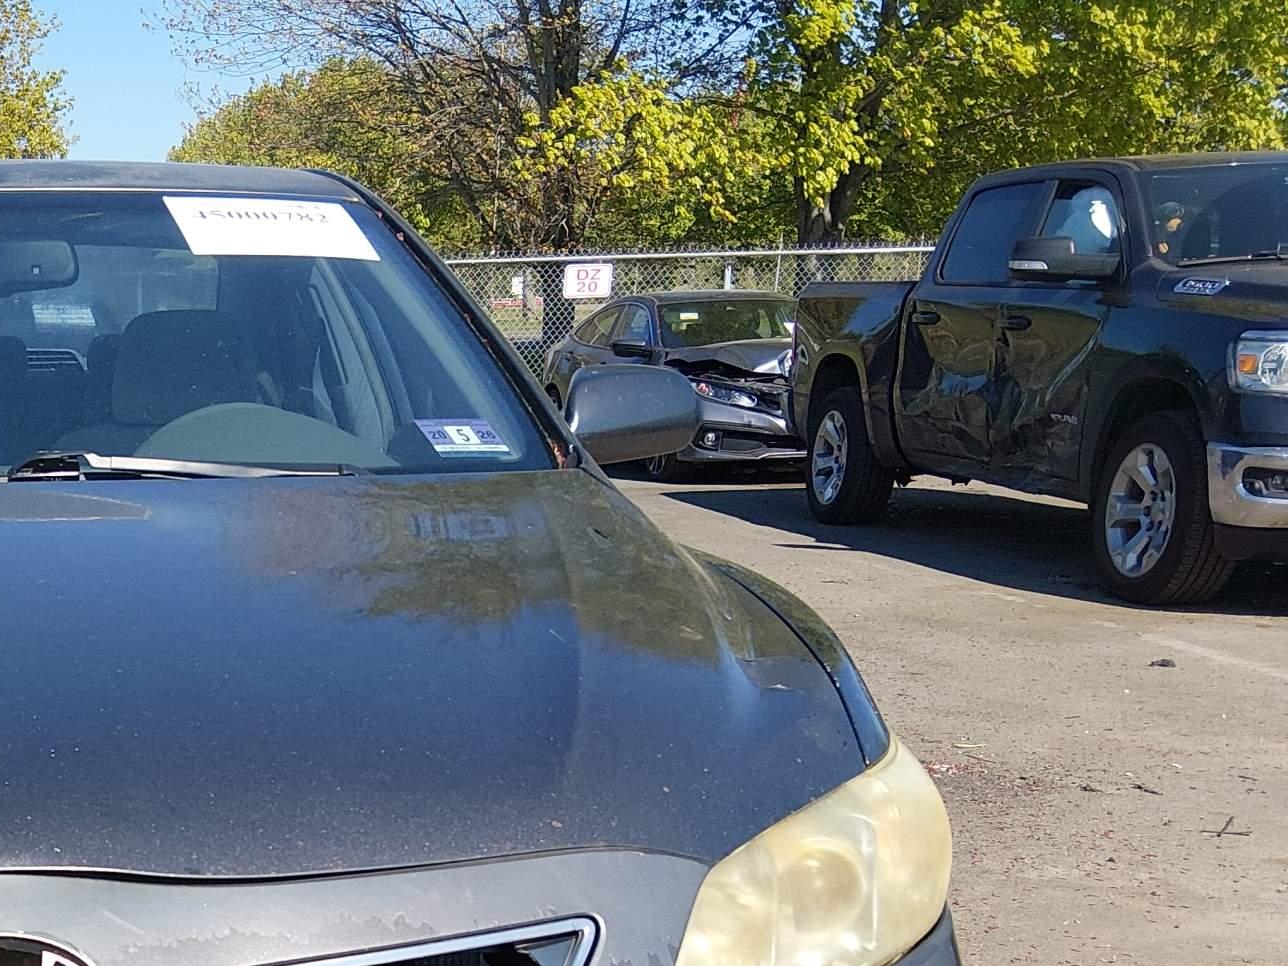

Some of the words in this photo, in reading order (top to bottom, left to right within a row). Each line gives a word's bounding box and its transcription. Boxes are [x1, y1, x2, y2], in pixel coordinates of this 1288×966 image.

[576, 268, 602, 281] DZ
[576, 281, 598, 293] 20
[428, 430, 447, 440] 20
[455, 428, 471, 442] 5
[476, 430, 496, 440] 26
